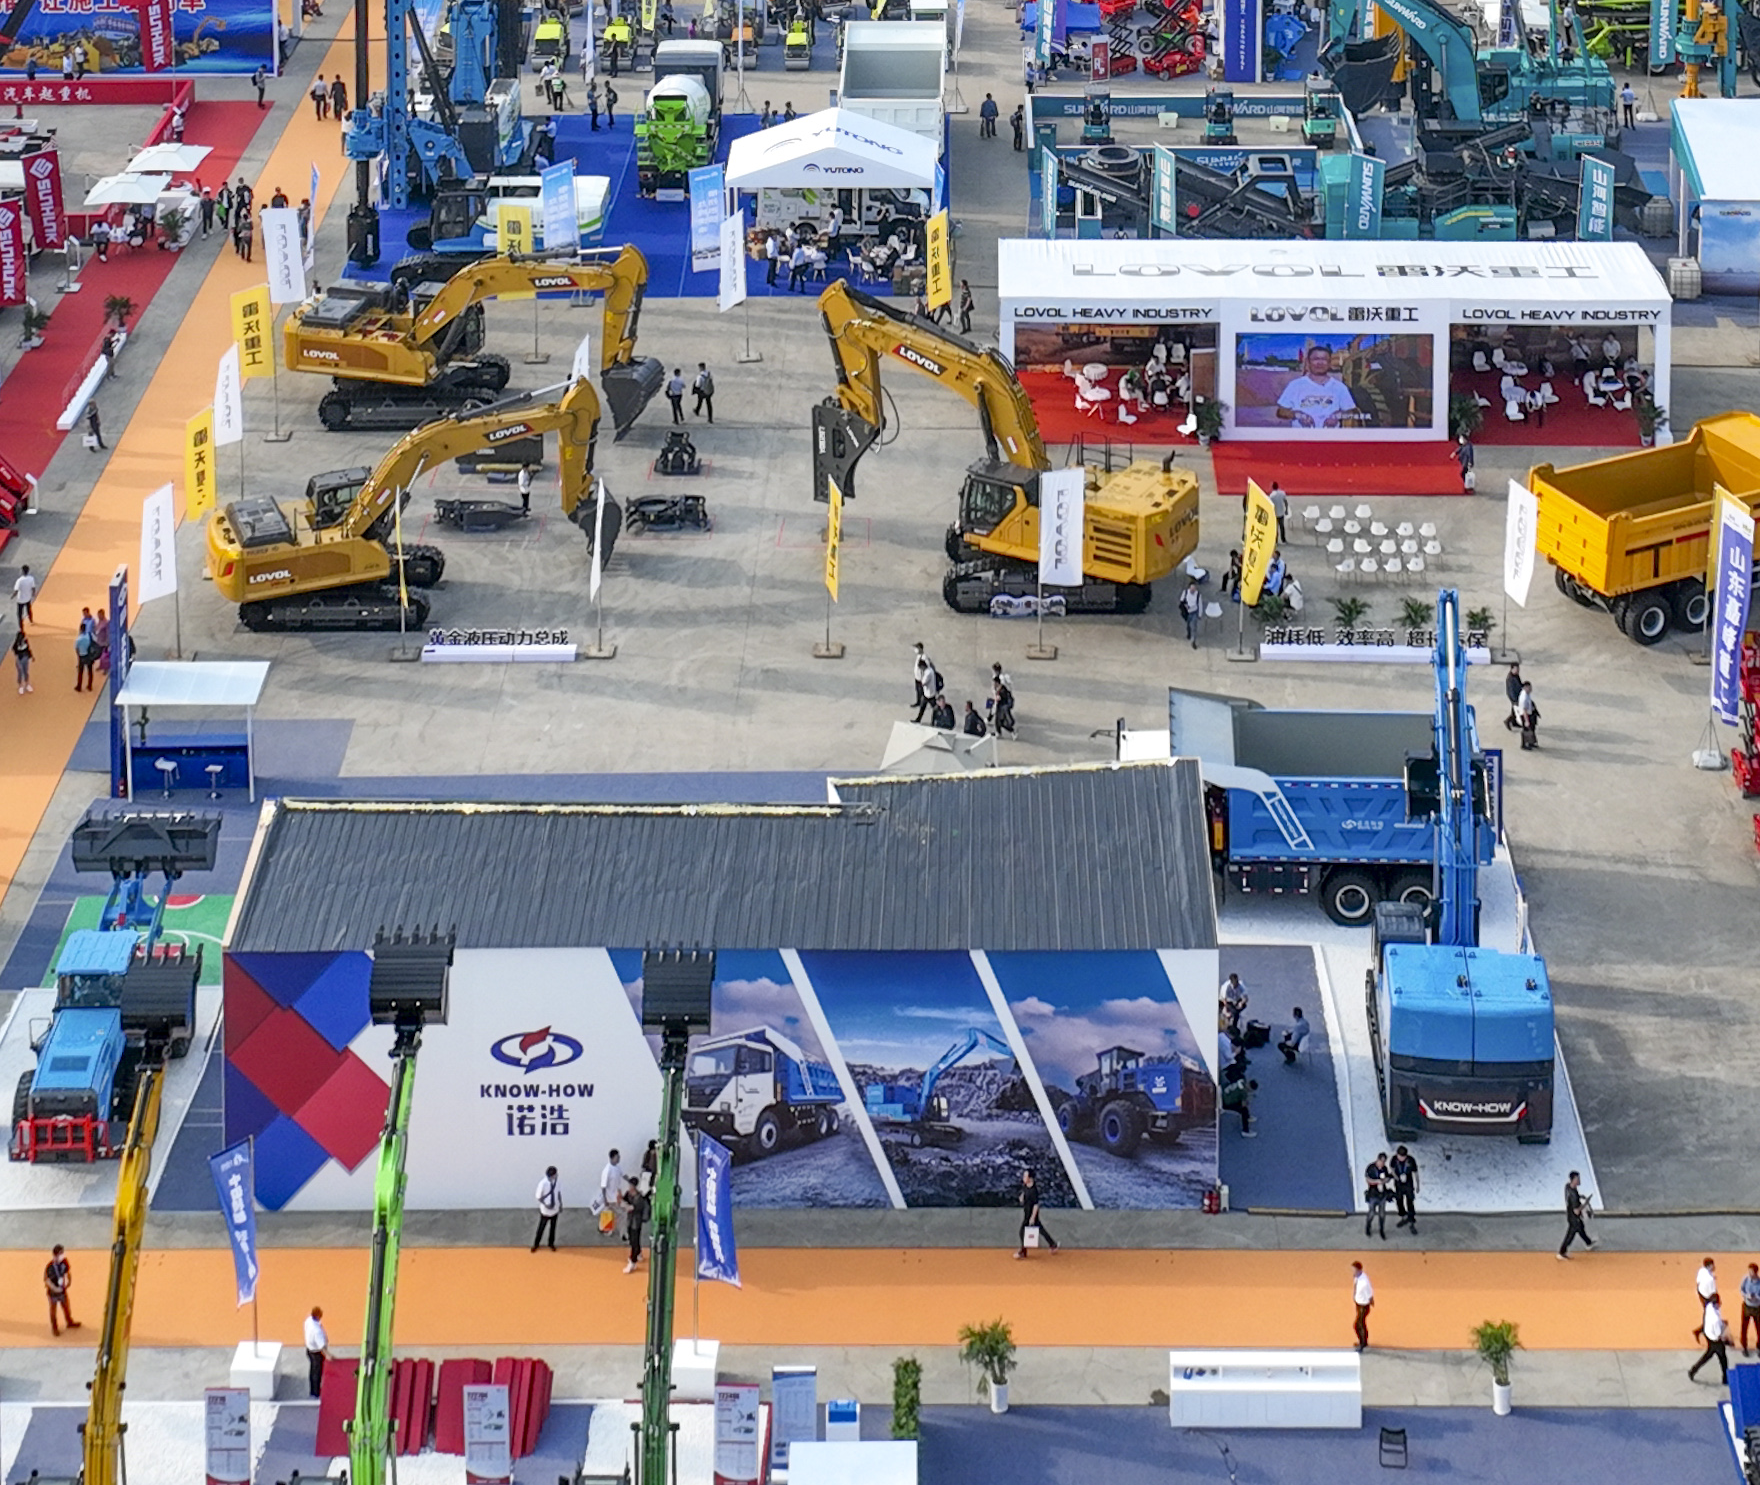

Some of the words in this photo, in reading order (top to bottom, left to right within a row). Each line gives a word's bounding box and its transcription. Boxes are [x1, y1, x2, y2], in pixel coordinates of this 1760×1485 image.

[149, 4, 166, 67] SUNHUNK
[813, 127, 904, 155] YUTONG
[823, 166, 864, 174] YUTONG
[1357, 161, 1374, 231] SUNWARD
[38, 177, 59, 244] SUNHUNK
[0, 228, 17, 301] SUNHUNK
[1073, 262, 1365, 278] LOVOL
[1376, 263, 1601, 280] 雷沃重工
[533, 276, 573, 287] LOVOL
[1014, 308, 1067, 318] LOVOL
[1072, 308, 1127, 319] HEAVY
[1132, 308, 1213, 319] INDUSTRY
[1251, 306, 1344, 322] LOVOL
[1347, 306, 1420, 322] 雷沃重工
[1463, 309, 1517, 320] LOVOL
[1521, 310, 1576, 320] HEAVY
[1581, 310, 1662, 321] INDUSTRY
[303, 349, 340, 361] LOVOL
[900, 345, 941, 375] LOVOL
[488, 424, 528, 441] LOVOL
[249, 569, 293, 583] LOVOL
[428, 629, 570, 647] 黄金液压动力总成
[1265, 627, 1326, 647] 油耗低
[1335, 627, 1396, 647] 效率高
[480, 1084, 595, 1098] KNOW-HOW
[1432, 1100, 1512, 1114] KNOW-HOW
[506, 1104, 570, 1137] 诺浩
